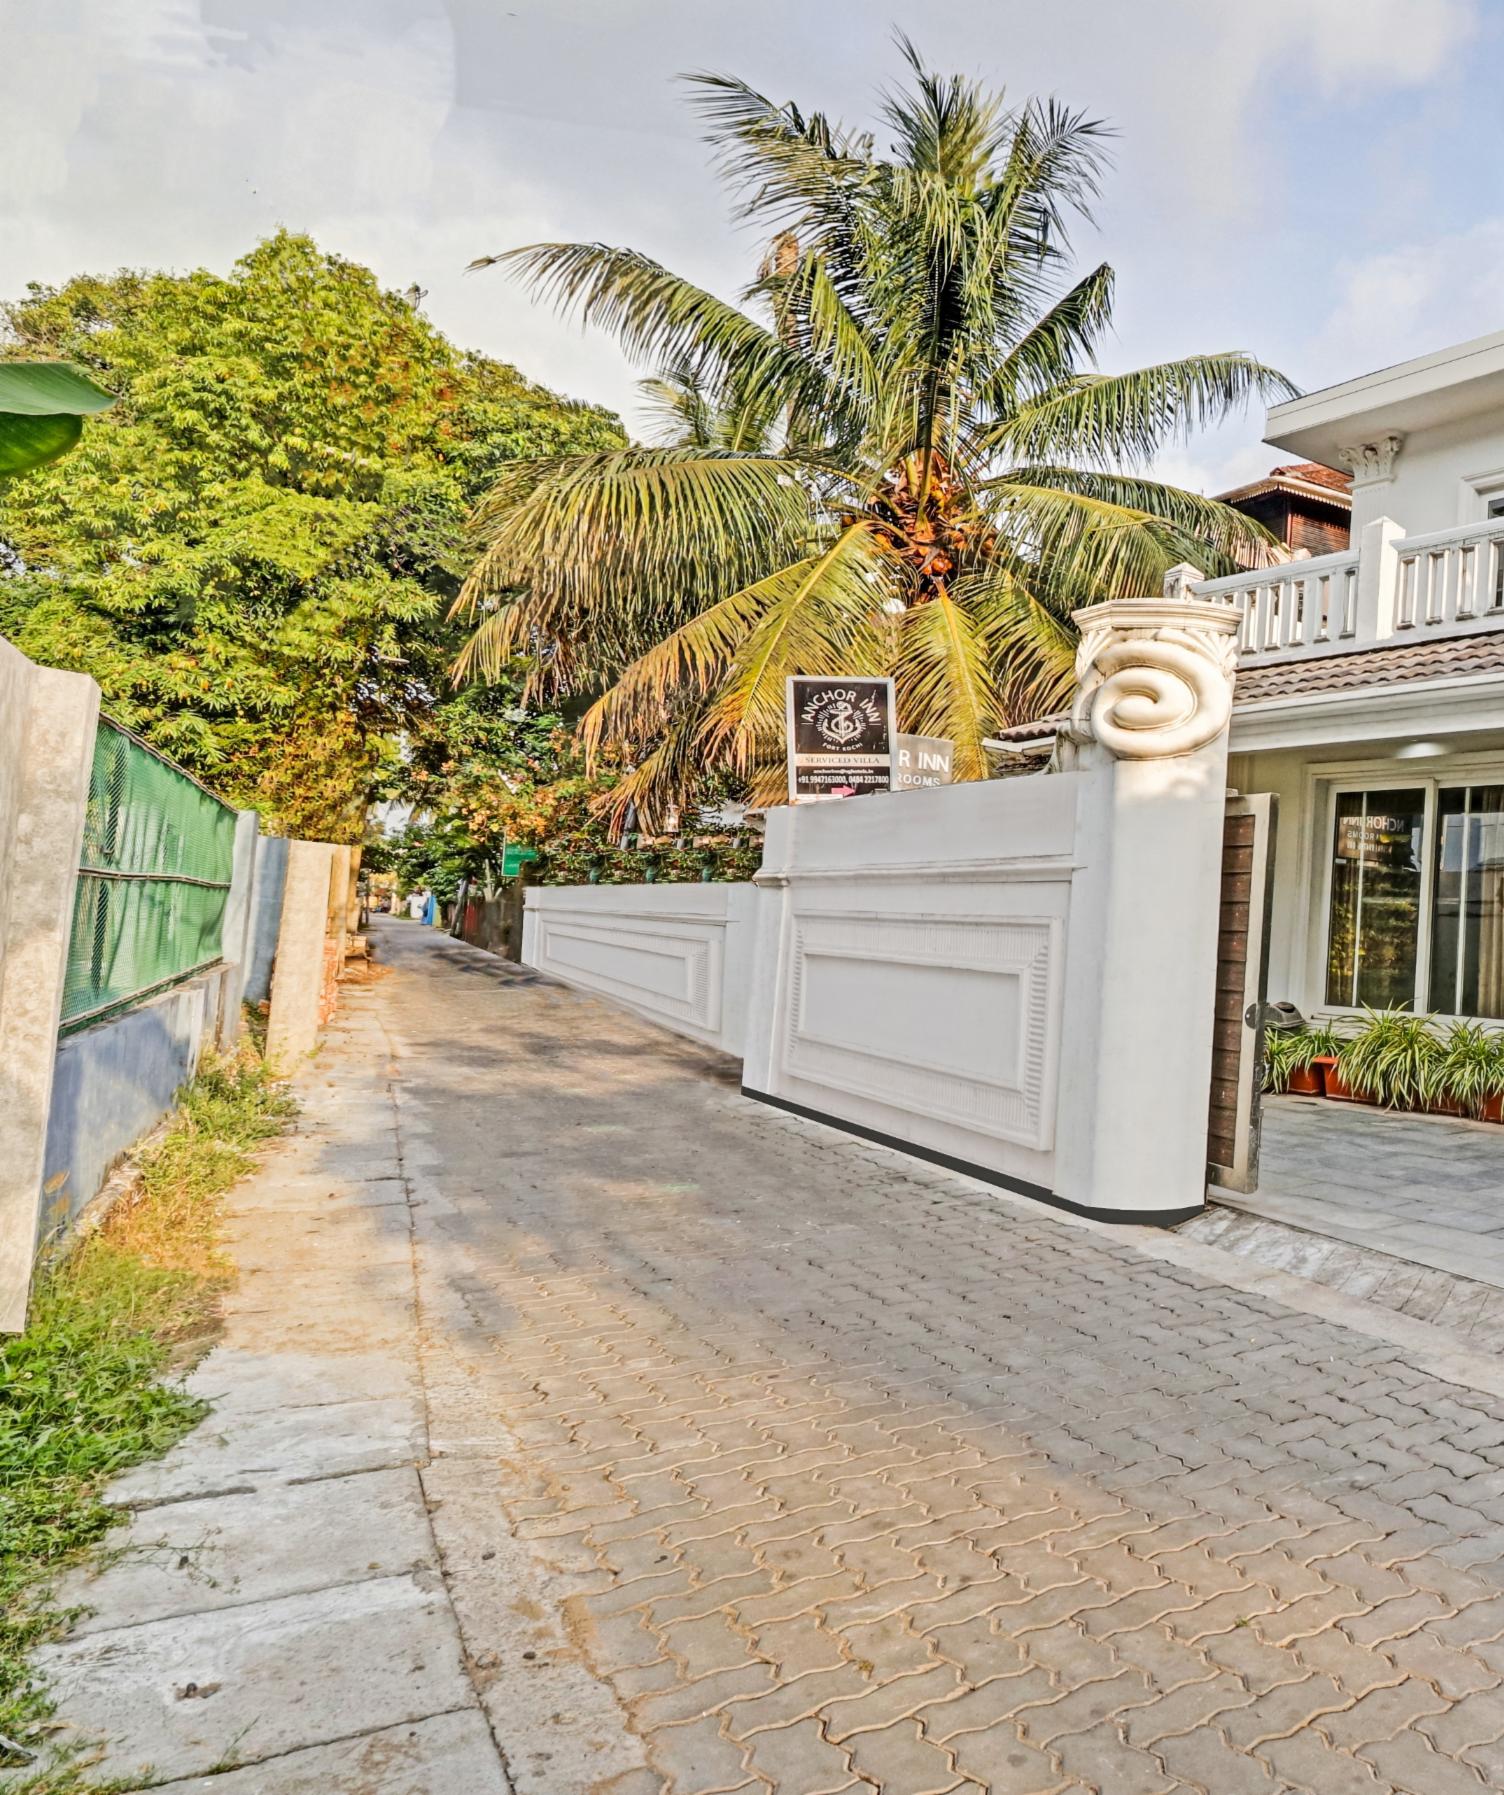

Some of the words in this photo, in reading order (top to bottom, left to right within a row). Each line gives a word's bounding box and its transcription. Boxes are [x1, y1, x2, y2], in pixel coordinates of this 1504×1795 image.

[801, 688, 857, 722] ANCHOR
[859, 698, 882, 722] INN
[822, 742, 840, 751] FORT
[842, 742, 863, 752] KOCHI
[918, 751, 950, 773] INN
